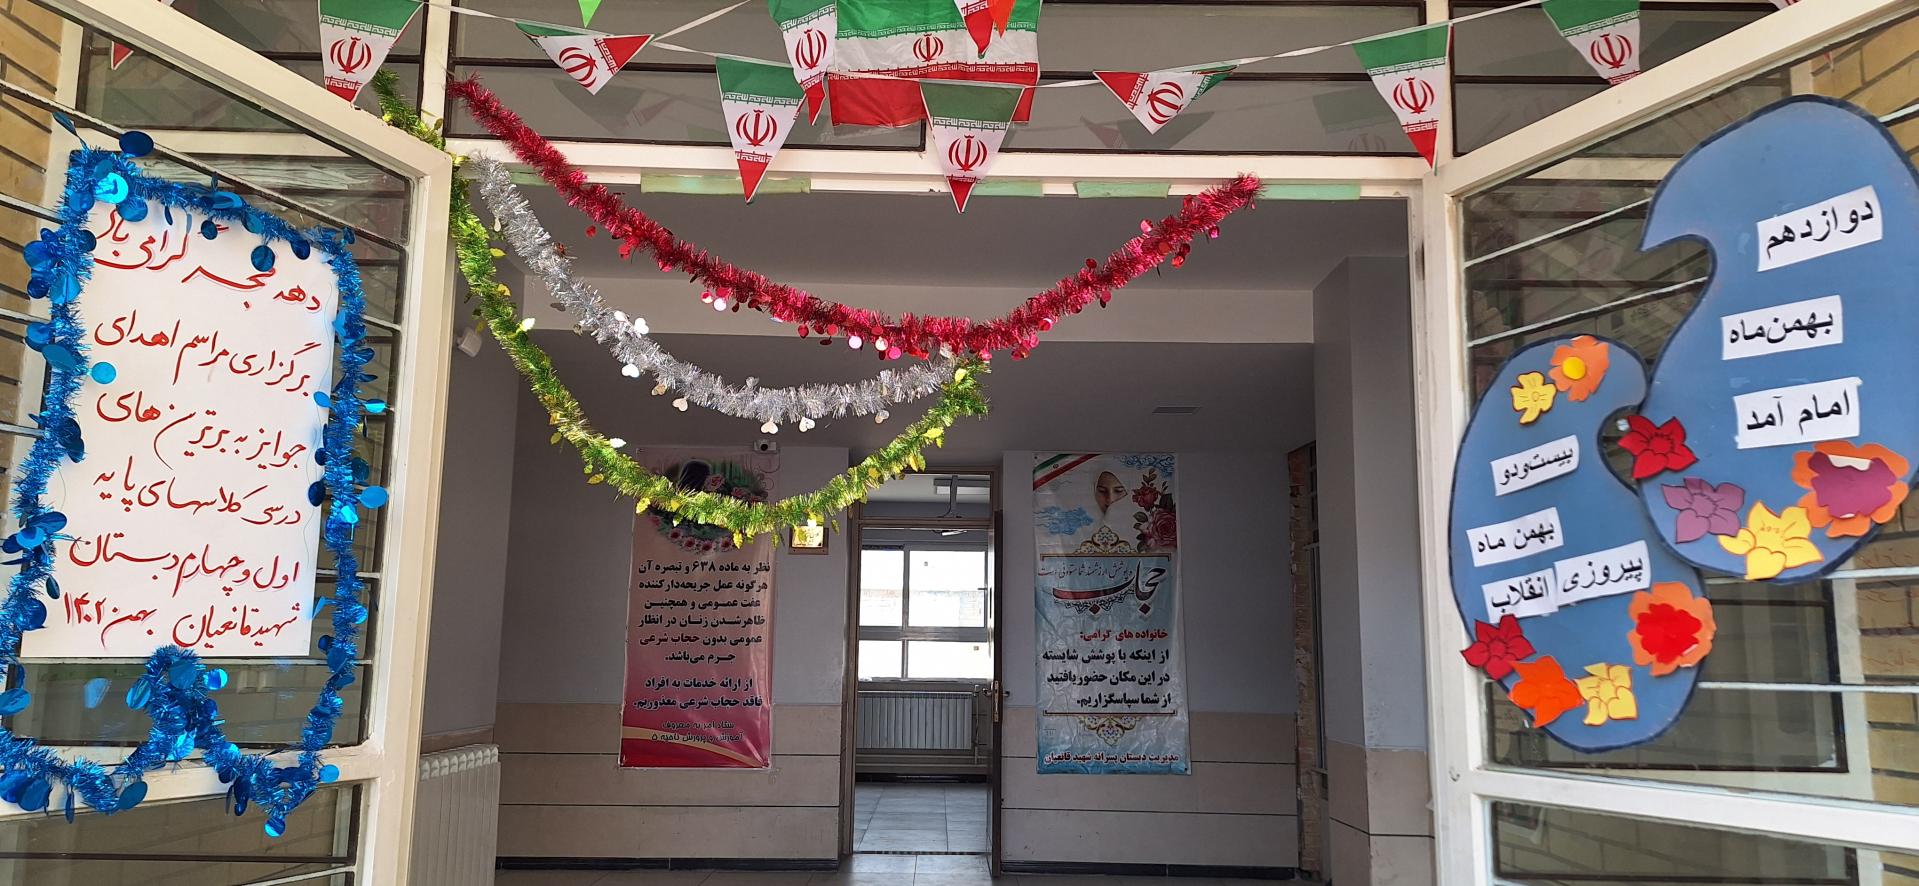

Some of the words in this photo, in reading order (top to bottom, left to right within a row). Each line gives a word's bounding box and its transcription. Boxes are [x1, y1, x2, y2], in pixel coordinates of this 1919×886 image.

[1766, 200, 1875, 260] دوازدهم
[93, 308, 181, 347] اهدای
[171, 330, 230, 386] مراسم
[228, 341, 322, 396] برگزاری
[96, 390, 162, 422] های
[1746, 396, 1784, 430] آمد
[1798, 389, 1850, 434] امام
[153, 404, 231, 471] برترین
[233, 434, 249, 455] به
[245, 428, 307, 470] جوایز
[240, 504, 301, 526] درسی
[1477, 534, 1506, 553] ماه
[1513, 522, 1554, 550] بهمن
[69, 532, 179, 580] دبستان
[171, 543, 245, 598] چهارم
[252, 555, 299, 589] اول
[638, 559, 653, 574] آن
[654, 562, 682, 575] تبصره
[684, 566, 690, 575] و
[691, 560, 716, 572] ۶۳۸
[718, 562, 740, 573] ماده
[741, 564, 751, 576] به
[754, 561, 771, 576] نظر
[231, 568, 251, 583] و
[1562, 557, 1644, 593] پیروزی
[713, 579, 733, 591] عمل
[1052, 560, 1167, 616] حجاب
[1490, 577, 1550, 613] انقلاب
[63, 591, 107, 625] ۱۴۰۲
[644, 598, 688, 610] همچنین
[689, 601, 696, 610] و
[698, 599, 739, 610] عمومی
[740, 599, 761, 608] عفت
[101, 605, 157, 648] بهمن
[250, 602, 301, 647] شهید
[638, 614, 663, 628] انظار
[665, 618, 677, 628] در
[679, 615, 709, 628] زنان
[639, 633, 669, 646] شرعی
[671, 632, 701, 643] حجاب
[702, 633, 728, 646] بدون
[729, 634, 763, 646] عمومی
[1115, 630, 1134, 642] های
[1135, 628, 1169, 642] خانواده
[707, 652, 736, 665] جرم
[1042, 648, 1079, 664] شایسته
[1081, 648, 1116, 664] پوشش
[1117, 649, 1127, 663] با
[1129, 648, 1156, 663] اینکه
[1159, 649, 1170, 664] از
[645, 677, 670, 691] افراد
[671, 679, 681, 691] به
[683, 677, 717, 689] خدمات
[719, 677, 742, 691] ارائه
[744, 677, 753, 691] از
[1046, 670, 1077, 687] یافتید
[1078, 670, 1108, 686] حضور
[1109, 670, 1137, 686] مکان
[1137, 671, 1156, 686] این
[1157, 673, 1170, 687] در
[679, 697, 709, 710] شرعی
[711, 696, 740, 707] حجاب
[742, 695, 763, 708] فاقد
[1140, 692, 1160, 706] شما
[1161, 692, 1172, 708] از
[1119, 751, 1147, 764] دبستان
